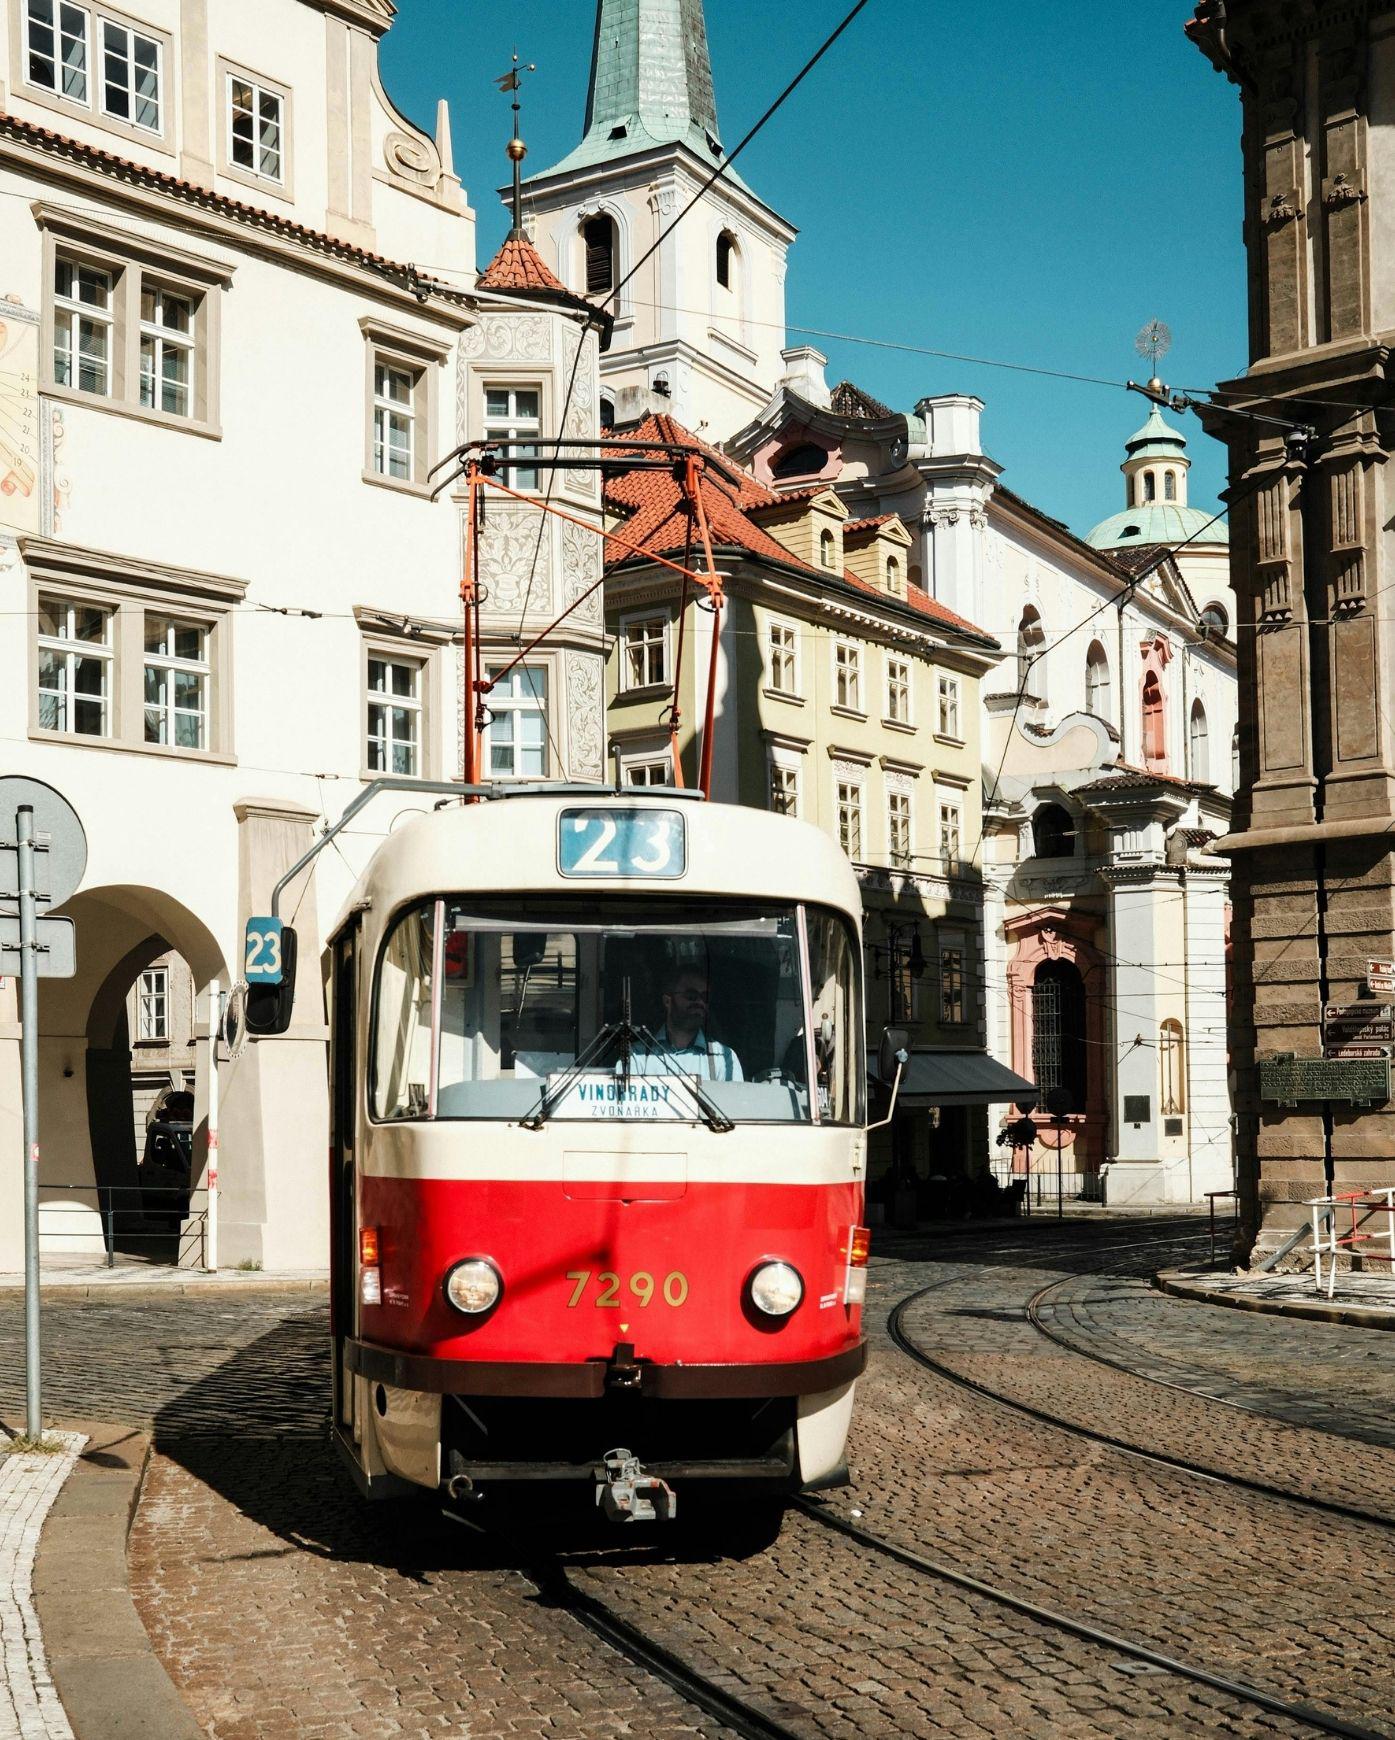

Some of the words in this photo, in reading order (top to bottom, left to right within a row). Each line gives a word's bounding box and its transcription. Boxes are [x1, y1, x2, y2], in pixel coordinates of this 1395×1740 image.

[22, 407, 33, 418] 22
[20, 443, 30, 454] 20
[571, 812, 671, 872] 23
[246, 931, 282, 974] 23
[577, 1084, 670, 1101] VINOHRADY
[566, 1271, 689, 1308] 7290
